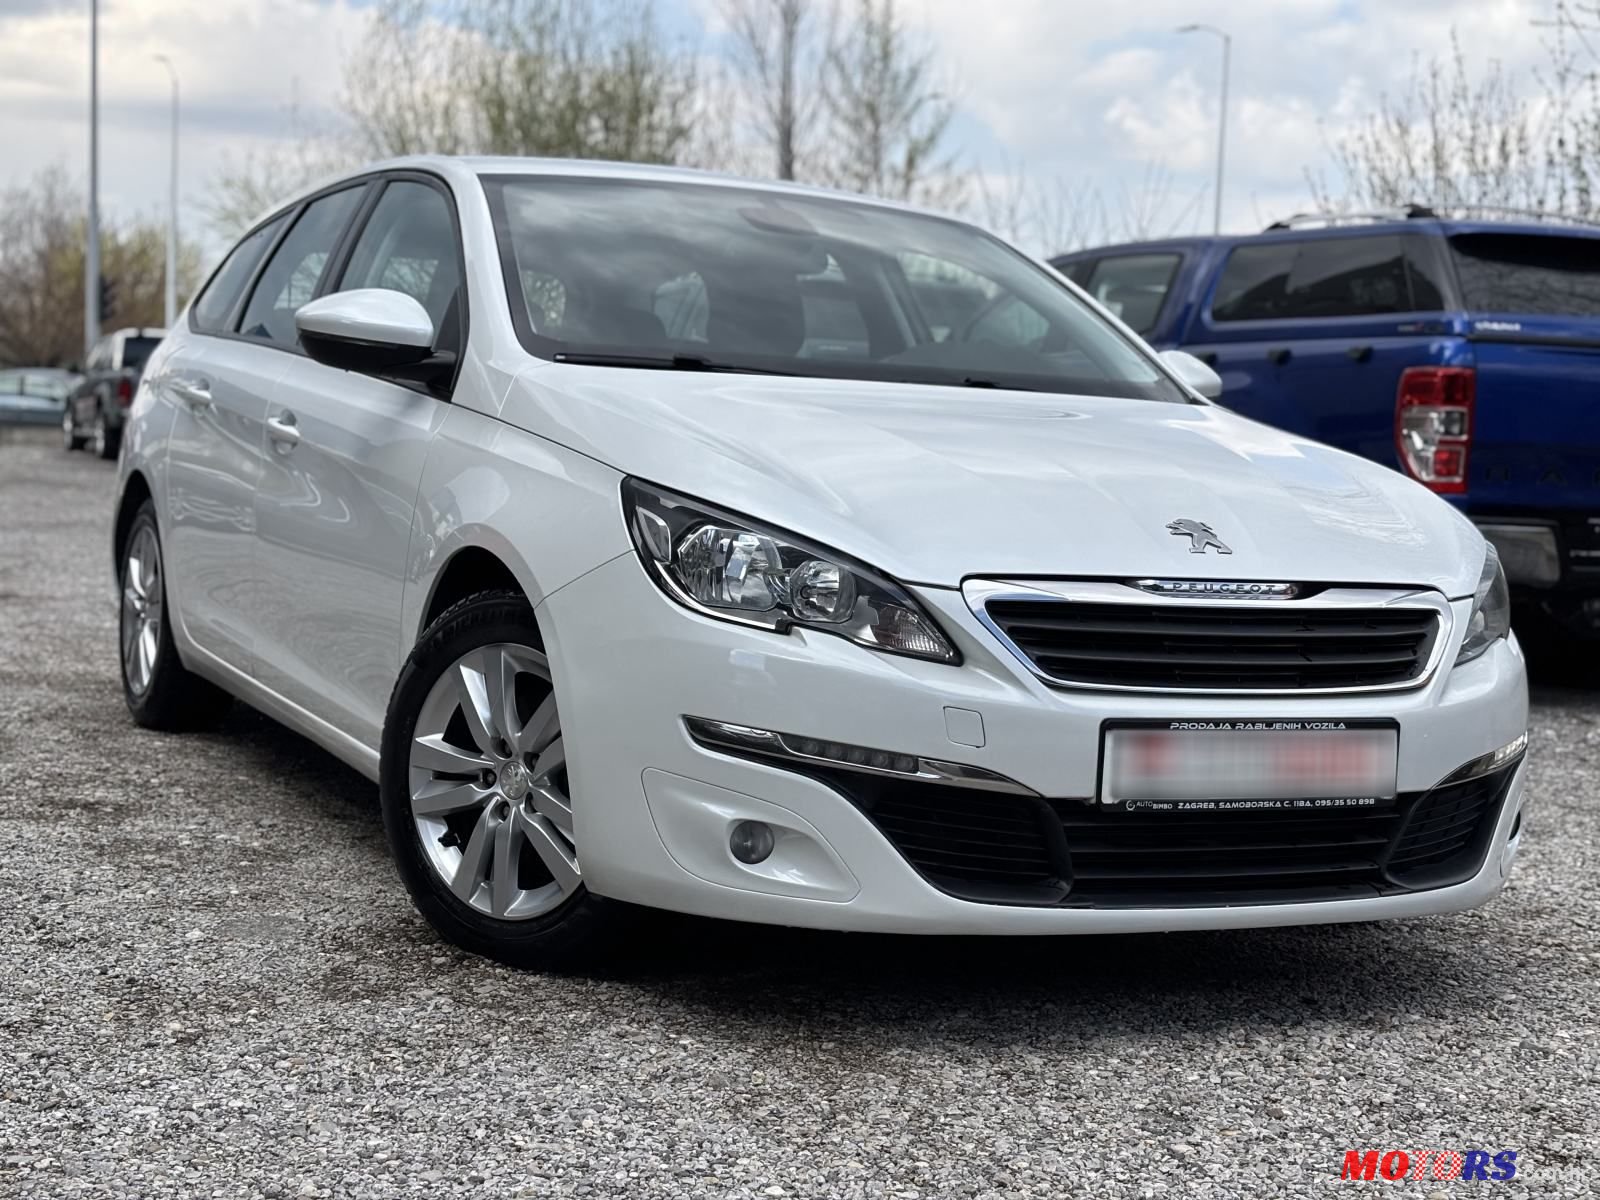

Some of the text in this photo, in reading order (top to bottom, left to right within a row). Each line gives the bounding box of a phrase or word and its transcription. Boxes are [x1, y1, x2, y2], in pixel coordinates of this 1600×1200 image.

[1172, 582, 1276, 595] PEUGEOT
[1170, 722, 1346, 730] PRODAJA RABLJENIH VOZILA
[1218, 801, 1281, 809] SAMOBORSKA
